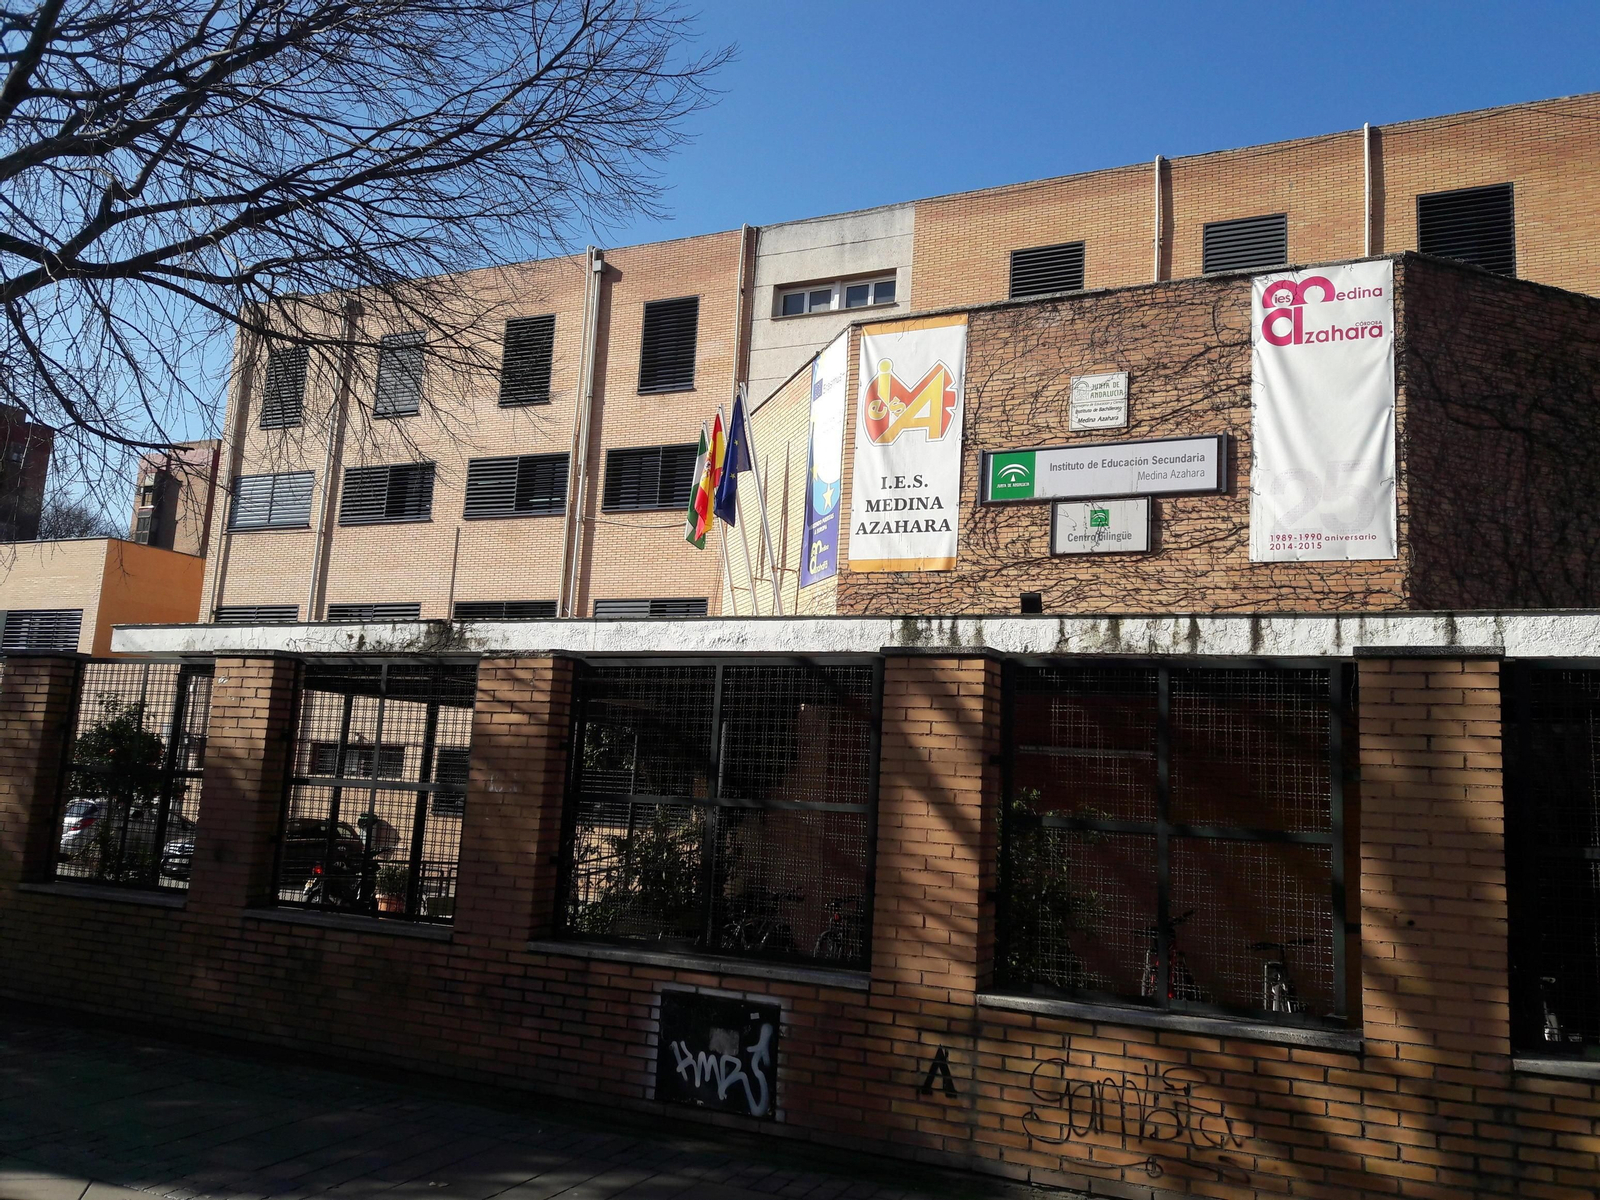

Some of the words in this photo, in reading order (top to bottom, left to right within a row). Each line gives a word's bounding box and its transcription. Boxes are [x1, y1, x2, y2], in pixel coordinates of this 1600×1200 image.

[1049, 461, 1085, 472] Instituto
[1087, 460, 1099, 469] de
[1101, 456, 1149, 469] Educación
[1151, 453, 1206, 465] Secundaria
[1137, 470, 1168, 481] Medina
[1170, 468, 1205, 479] Azahara
[880, 475, 929, 490] I.E.S.
[865, 496, 944, 512] MEDINA
[855, 518, 952, 535] AZAHARA
[1067, 533, 1096, 542] Centro
[1324, 533, 1377, 542] aniversario
